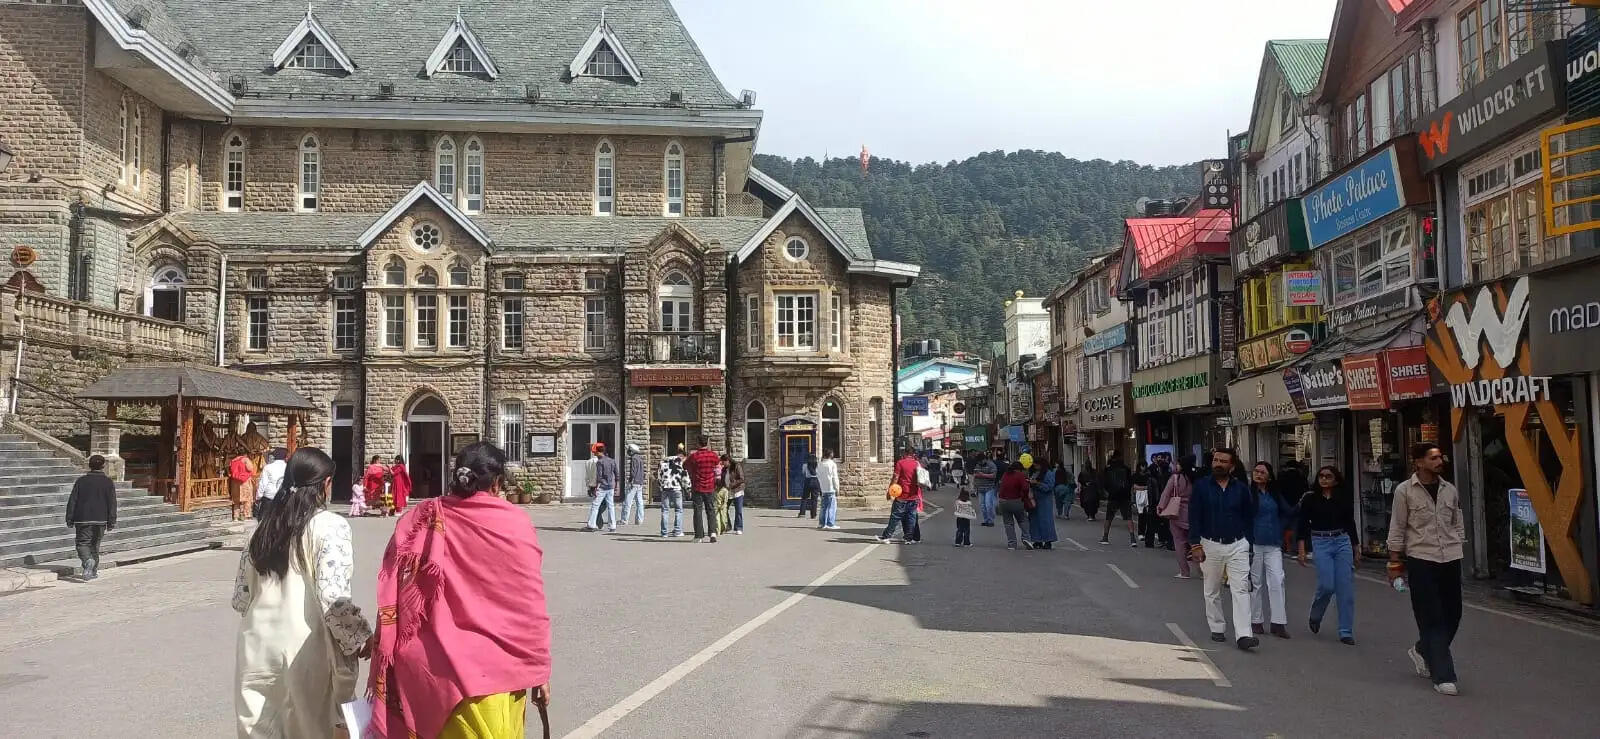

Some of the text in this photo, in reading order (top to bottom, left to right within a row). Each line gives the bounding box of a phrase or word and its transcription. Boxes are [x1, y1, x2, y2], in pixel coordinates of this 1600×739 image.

[1567, 42, 1600, 83] wa
[1457, 65, 1546, 136] WILDCRAFT
[1312, 190, 1344, 224] Photo
[1346, 169, 1388, 207] Palace
[1334, 310, 1352, 327] Photo
[1354, 303, 1377, 321] Palace
[1302, 365, 1344, 390] Sathe's
[1347, 367, 1378, 391] SHREE
[1391, 363, 1428, 378] SHREE
[1084, 395, 1121, 413] OCTAVE
[1450, 375, 1553, 409] WILDCRAFT
